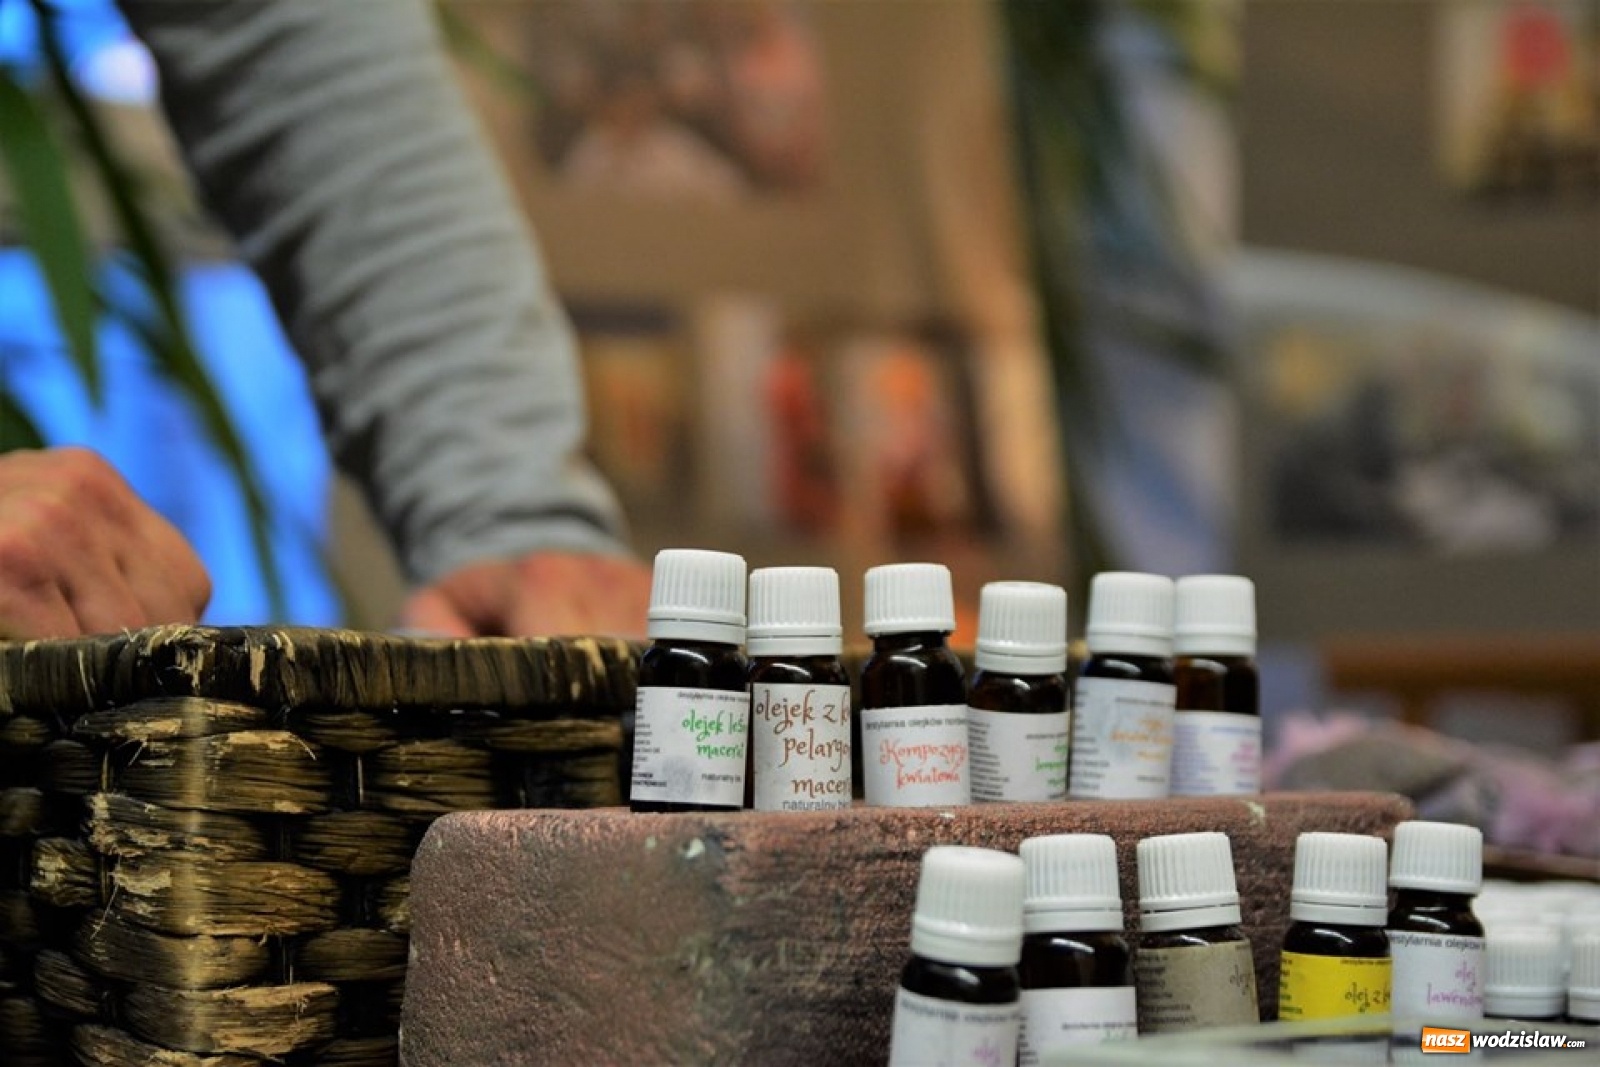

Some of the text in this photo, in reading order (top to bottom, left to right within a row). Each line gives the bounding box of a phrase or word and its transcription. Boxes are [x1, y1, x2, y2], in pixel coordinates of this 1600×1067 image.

[682, 708, 725, 743] olejek
[755, 688, 816, 735] olejek
[823, 704, 838, 723] z
